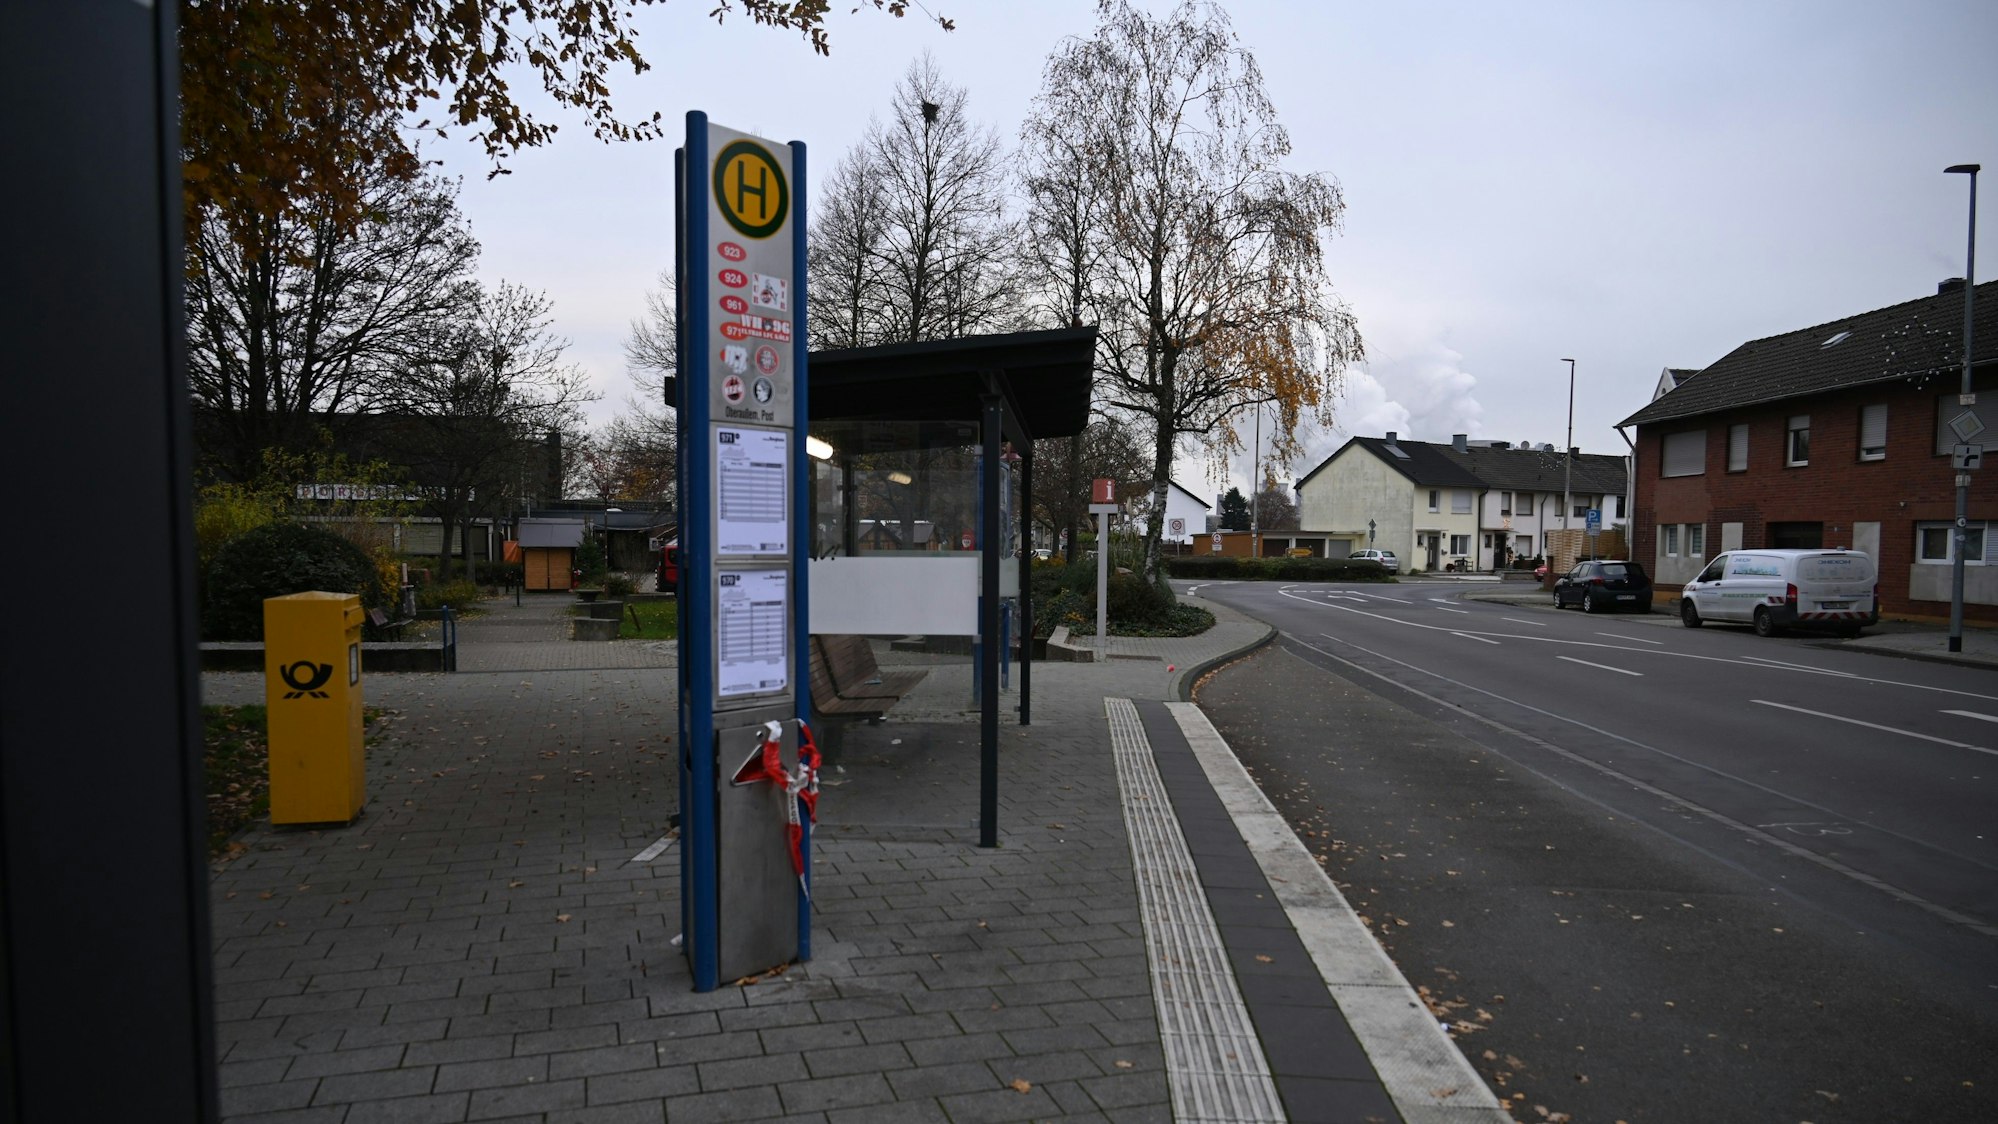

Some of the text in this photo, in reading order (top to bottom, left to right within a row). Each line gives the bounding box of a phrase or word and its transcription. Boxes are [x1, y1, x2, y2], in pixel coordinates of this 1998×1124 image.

[738, 160, 766, 219] H
[723, 246, 741, 259] 923
[724, 272, 742, 284] 924
[726, 299, 742, 311] 961
[726, 325, 742, 337] 971
[1588, 511, 1597, 522] P
